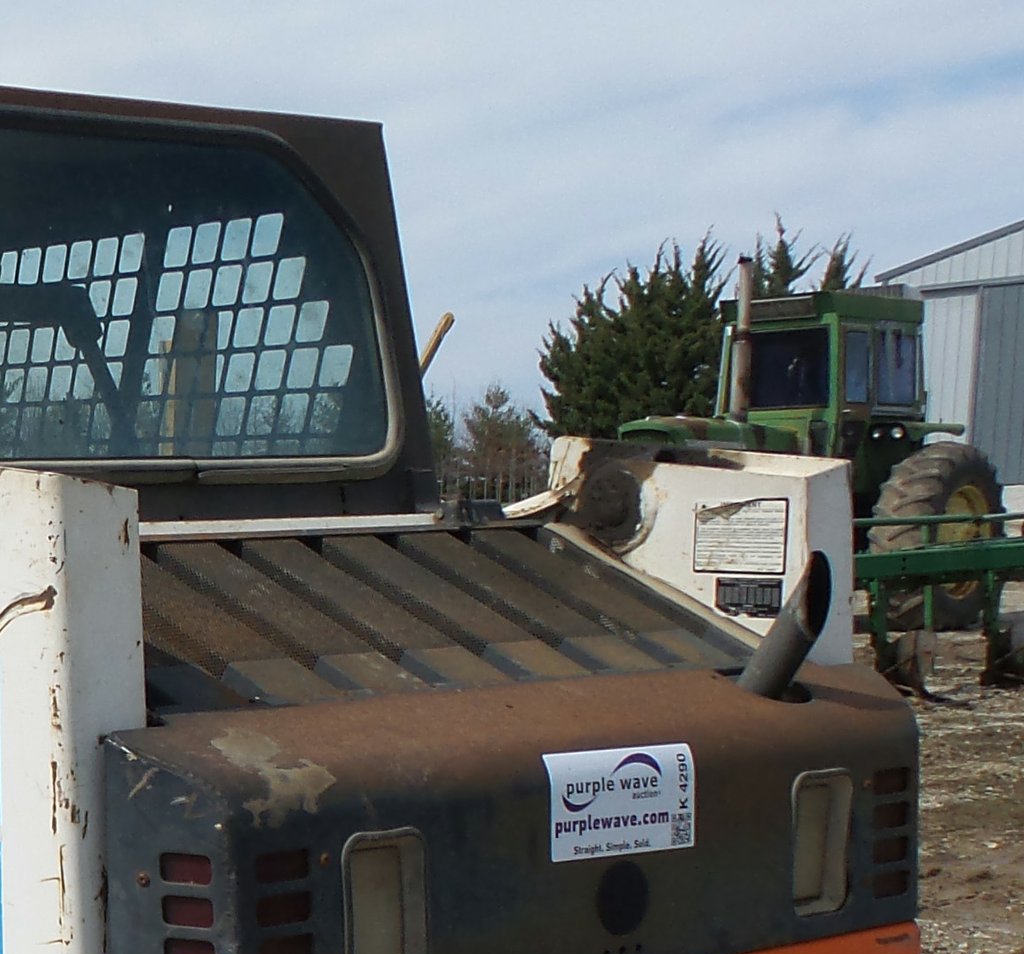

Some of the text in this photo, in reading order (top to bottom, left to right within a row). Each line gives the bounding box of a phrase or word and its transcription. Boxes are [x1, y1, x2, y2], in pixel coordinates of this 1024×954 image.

[566, 776, 658, 798] purple wave
[676, 753, 688, 809] K 4290
[555, 811, 669, 838] purplewave.com
[573, 838, 652, 856] Straight. Simple. Sold.
